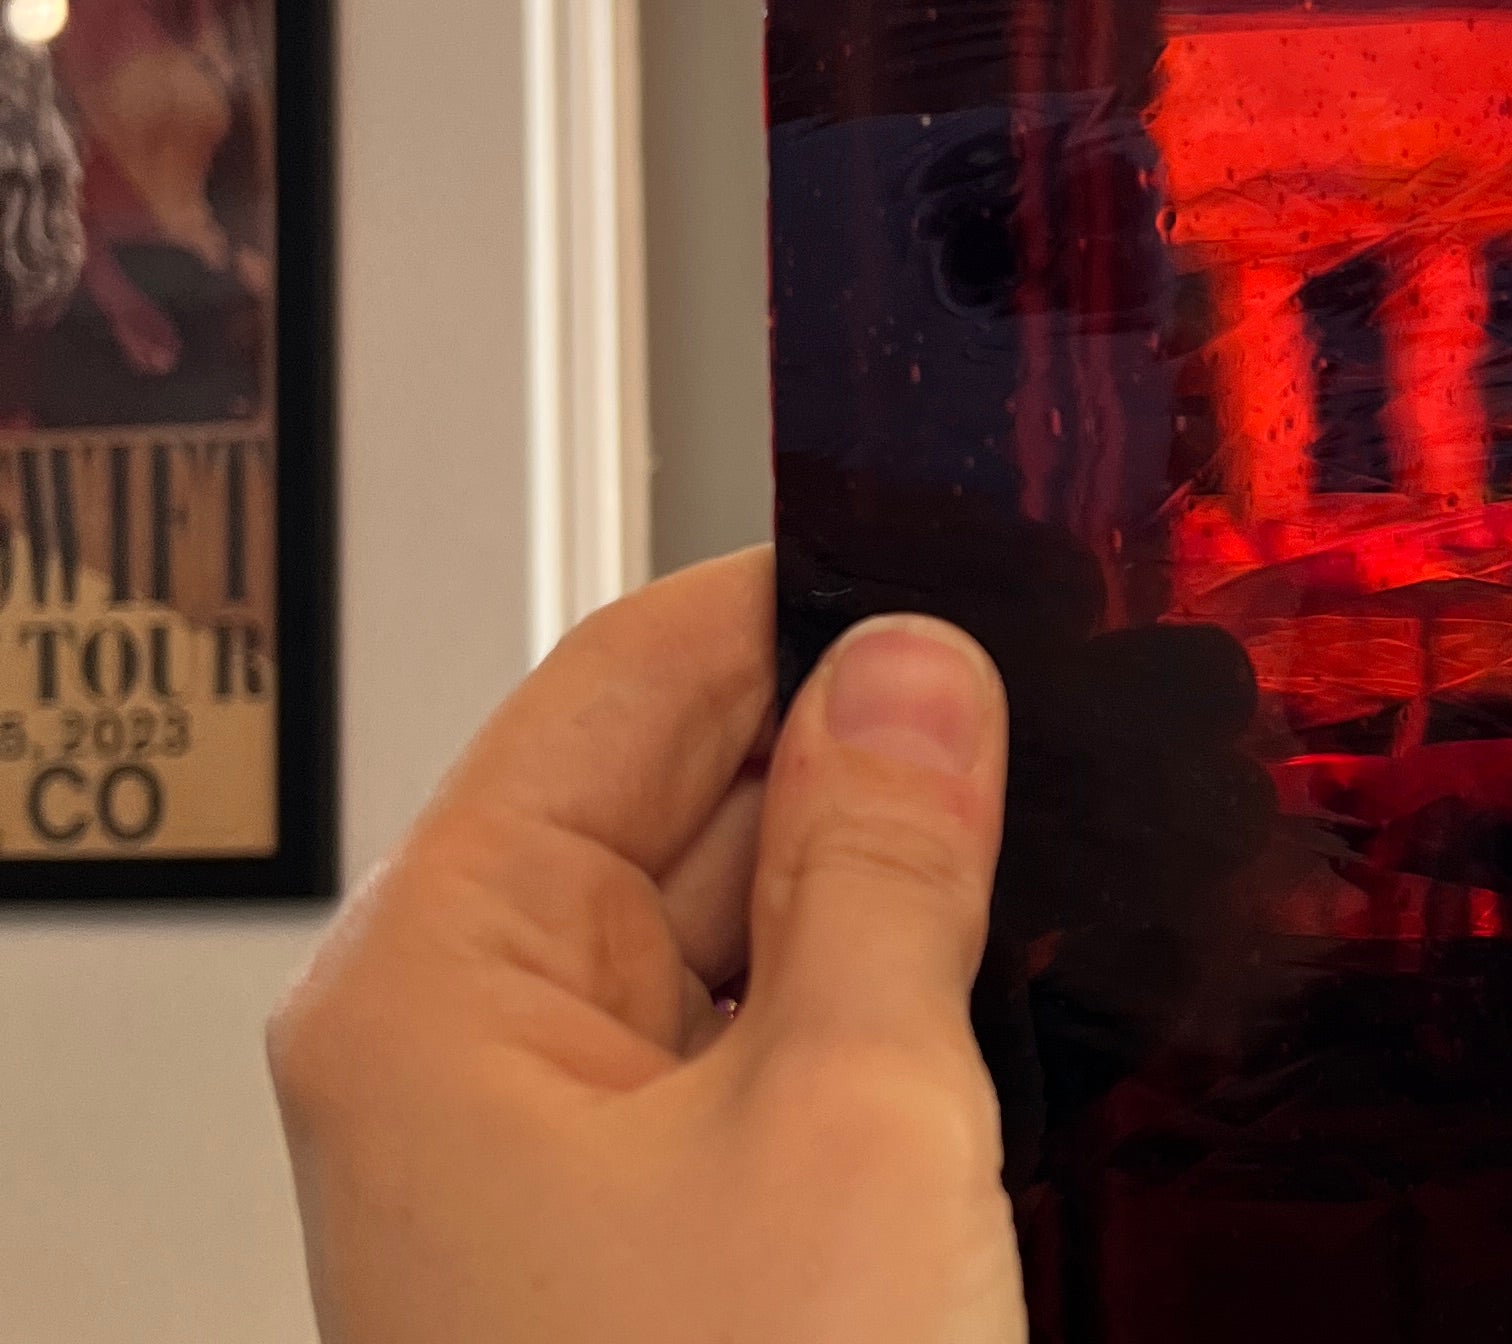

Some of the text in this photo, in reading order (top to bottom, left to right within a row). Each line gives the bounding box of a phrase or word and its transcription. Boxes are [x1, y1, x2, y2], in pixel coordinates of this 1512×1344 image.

[0, 436, 276, 610] WIFT
[19, 618, 270, 701] TOUR
[60, 706, 193, 759] 2023
[27, 765, 166, 843] CO
